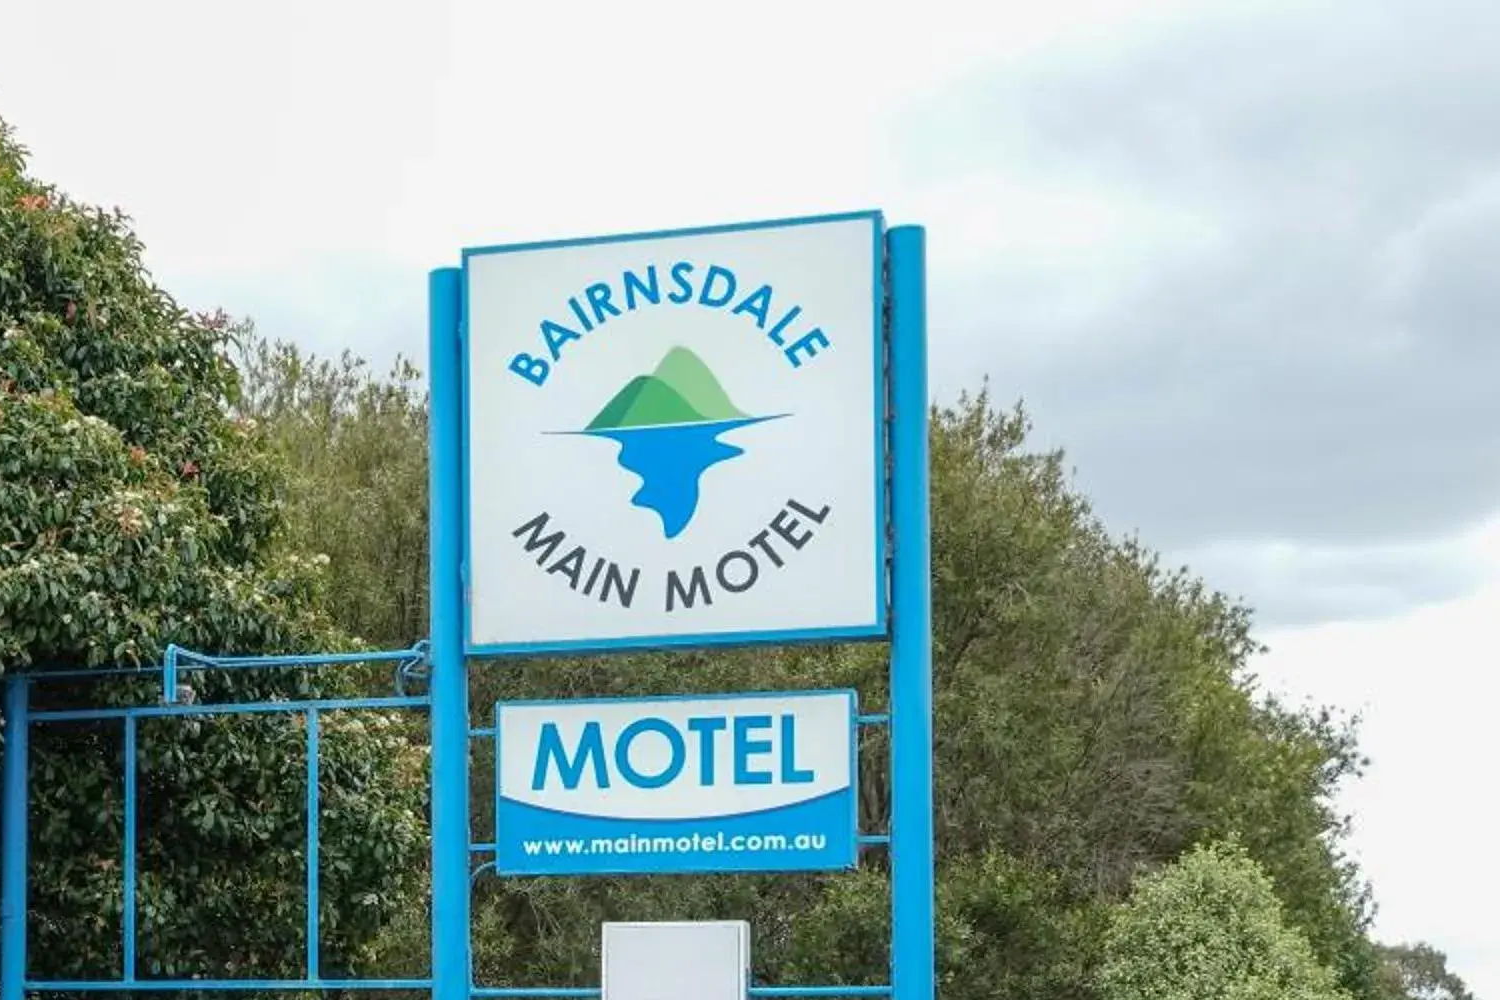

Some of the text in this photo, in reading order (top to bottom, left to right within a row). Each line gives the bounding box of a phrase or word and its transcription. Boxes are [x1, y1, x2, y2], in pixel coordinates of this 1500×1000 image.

[508, 261, 830, 387] BAIRNSDALE
[512, 499, 832, 612] MAIN MOTEL
[531, 714, 815, 791] MOTEL
[523, 832, 826, 855] www.mainmotel.com.au
